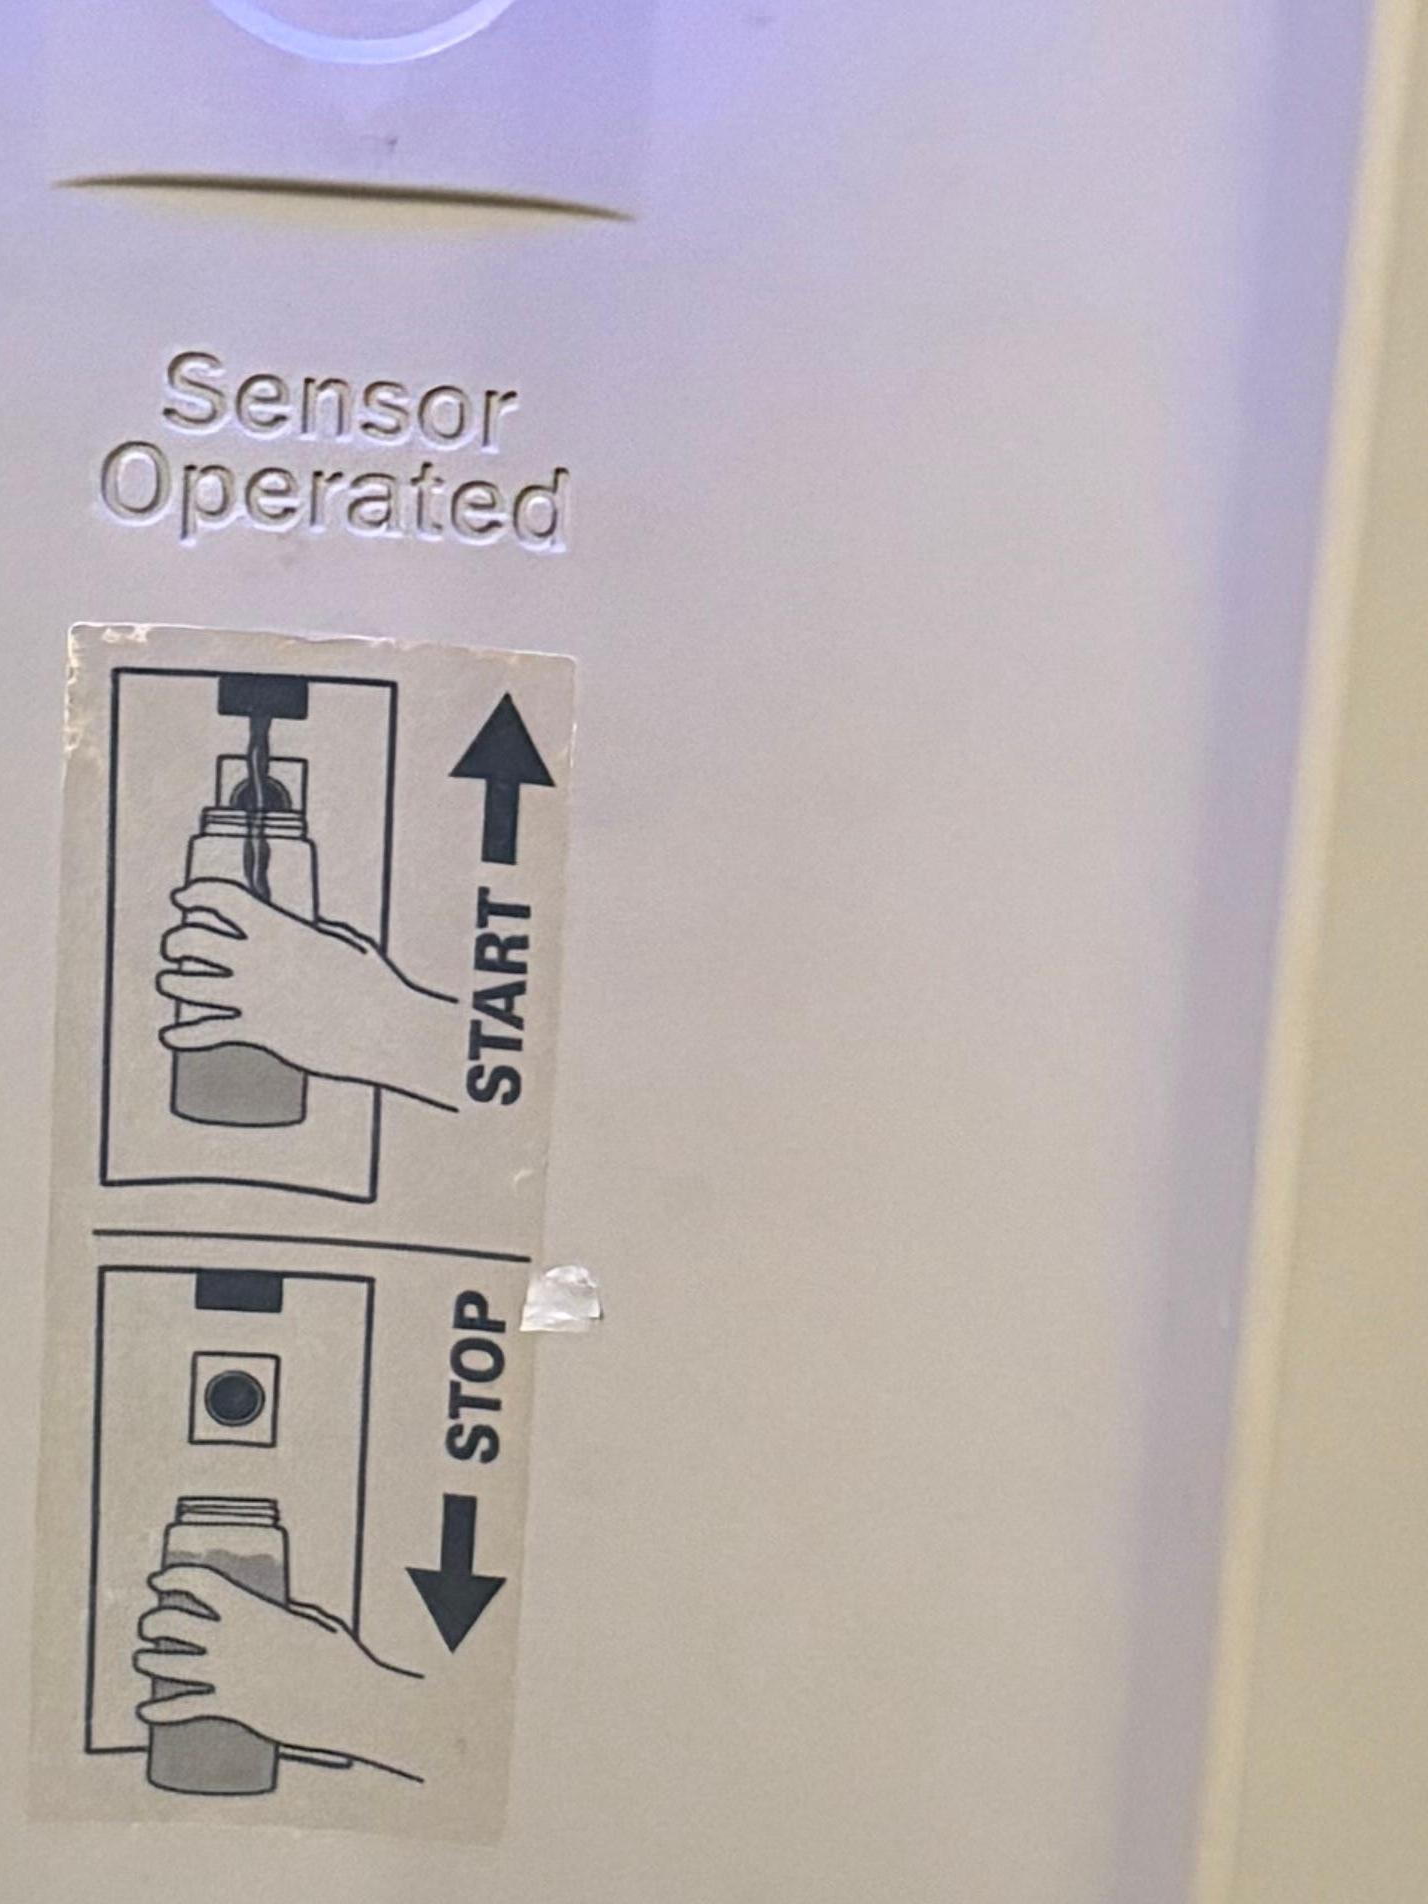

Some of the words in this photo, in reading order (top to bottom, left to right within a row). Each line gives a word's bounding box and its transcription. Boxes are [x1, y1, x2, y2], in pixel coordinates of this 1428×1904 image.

[161, 349, 520, 454] Sensor
[98, 439, 570, 554] Operated
[465, 885, 532, 1106] START
[444, 1289, 508, 1465] STOP
